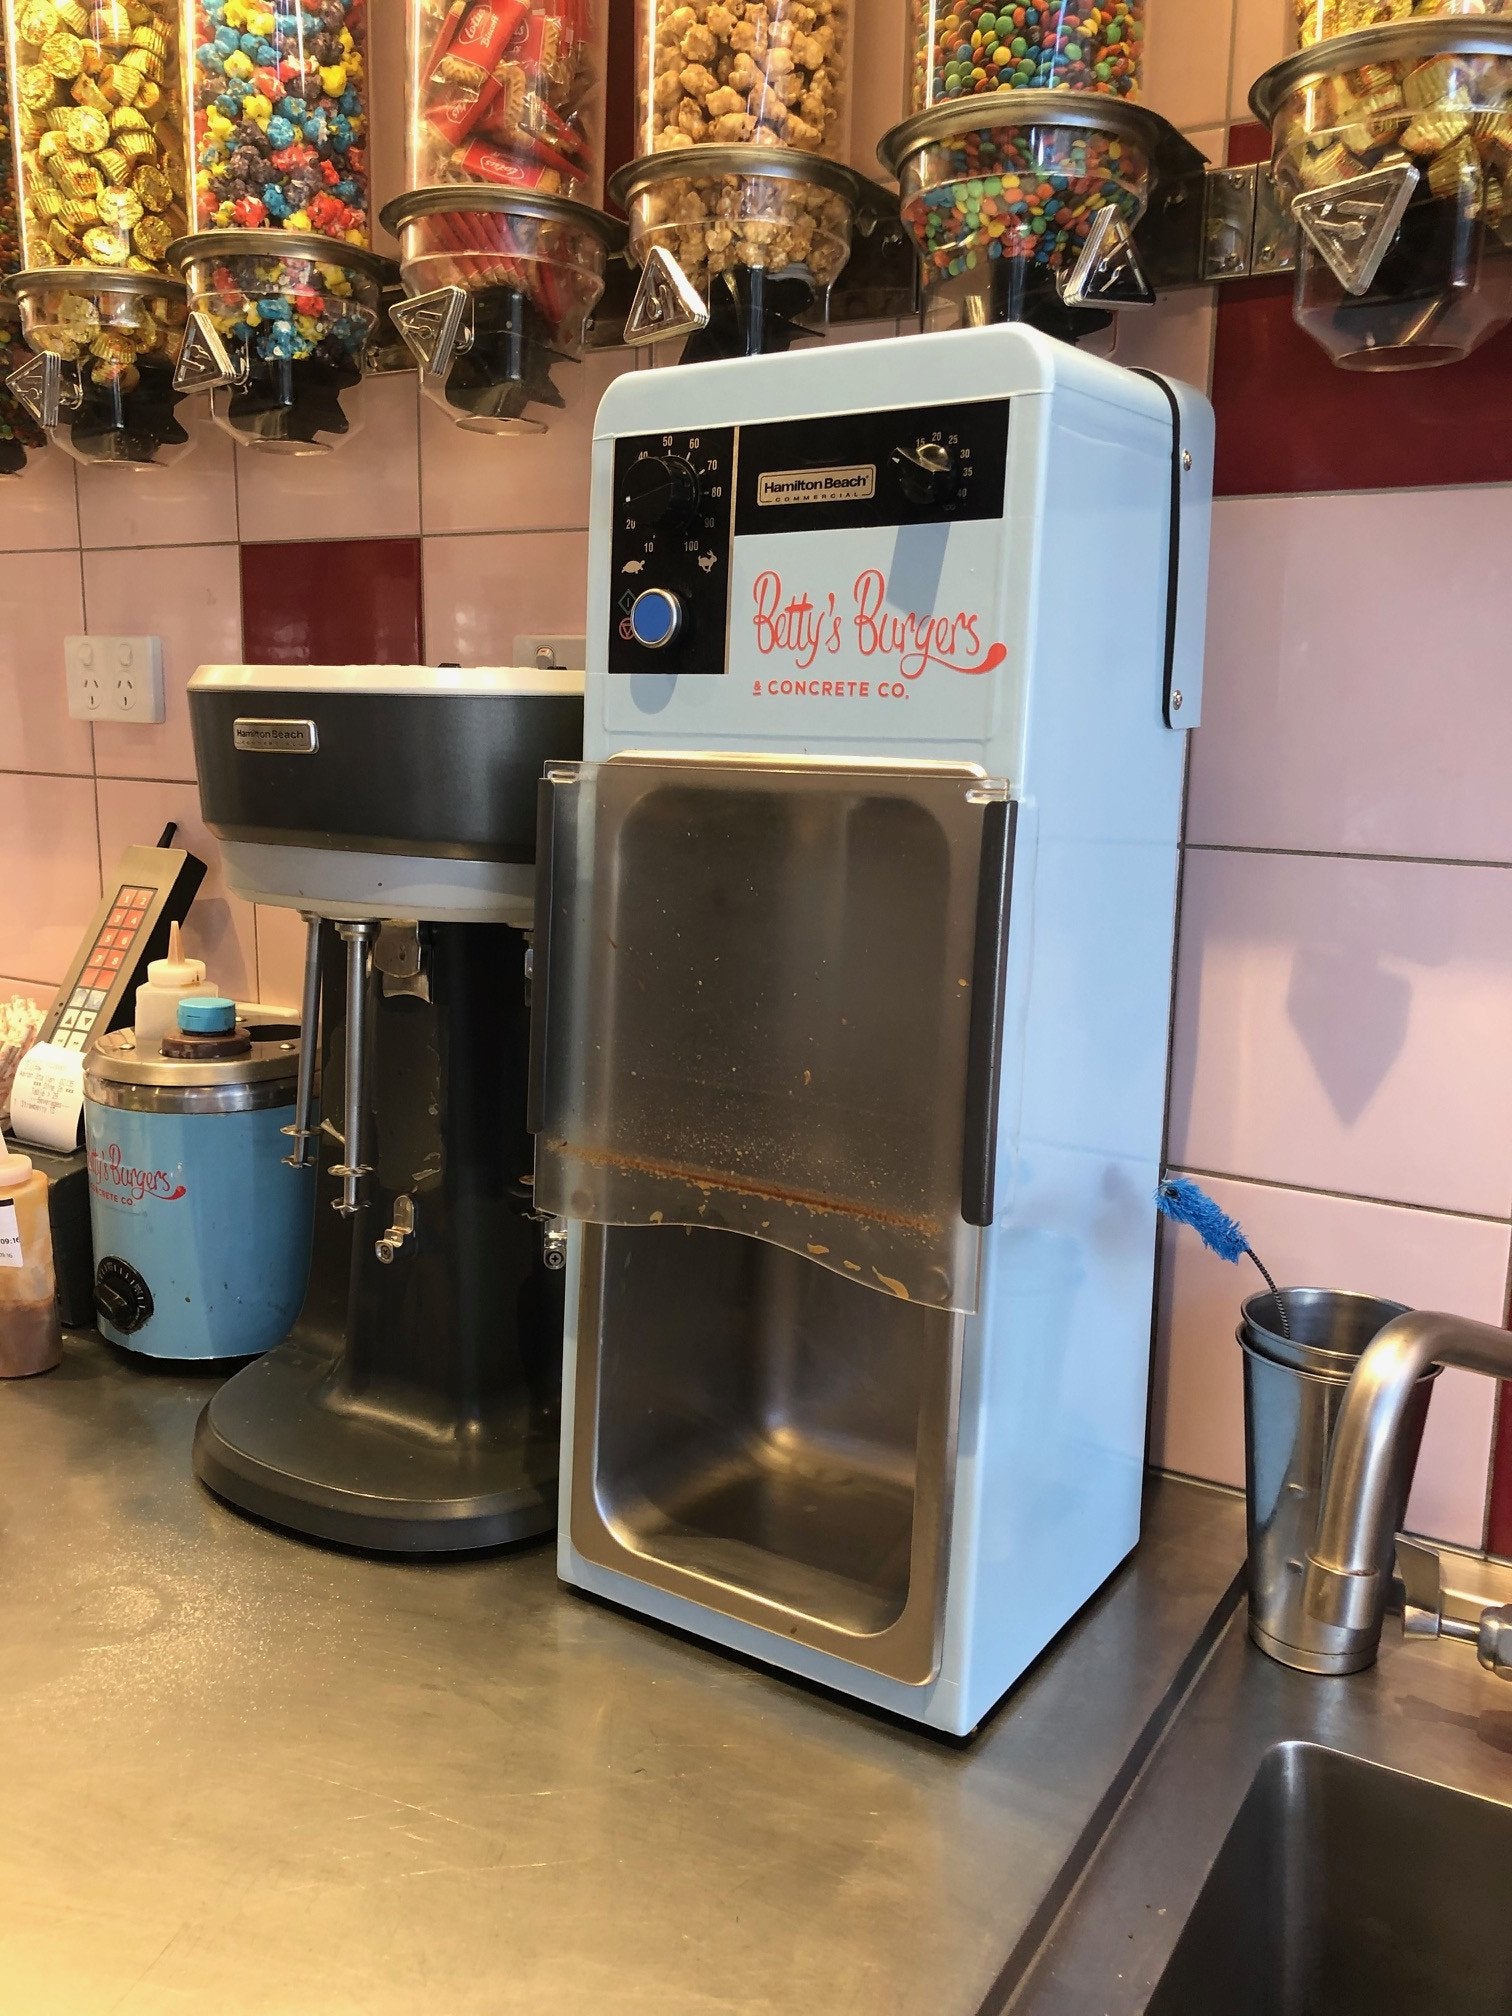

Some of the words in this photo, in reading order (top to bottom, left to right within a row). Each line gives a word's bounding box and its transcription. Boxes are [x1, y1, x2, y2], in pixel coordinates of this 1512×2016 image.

[662, 435, 673, 447] 50
[932, 431, 942, 442] 20
[948, 434, 958, 445] 25
[689, 437, 700, 449] 60
[960, 448, 970, 459] 30
[707, 459, 718, 471] 70
[962, 467, 973, 477] 35
[711, 486, 722, 498] 80
[764, 479, 823, 494] Hamilton
[775, 492, 858, 503] COMMERCIAL
[625, 518, 636, 530] 20
[704, 517, 715, 528] 90
[644, 541, 654, 553] 10
[684, 540, 699, 551] 100
[752, 568, 842, 670] Betty's
[853, 568, 1008, 680] Burgers
[752, 680, 762, 696] &
[768, 679, 870, 698] CONCRETE
[877, 681, 910, 700] CO.
[236, 728, 271, 739] Hamilton
[271, 729, 304, 739] Beach
[109, 1143, 187, 1201] Burgers
